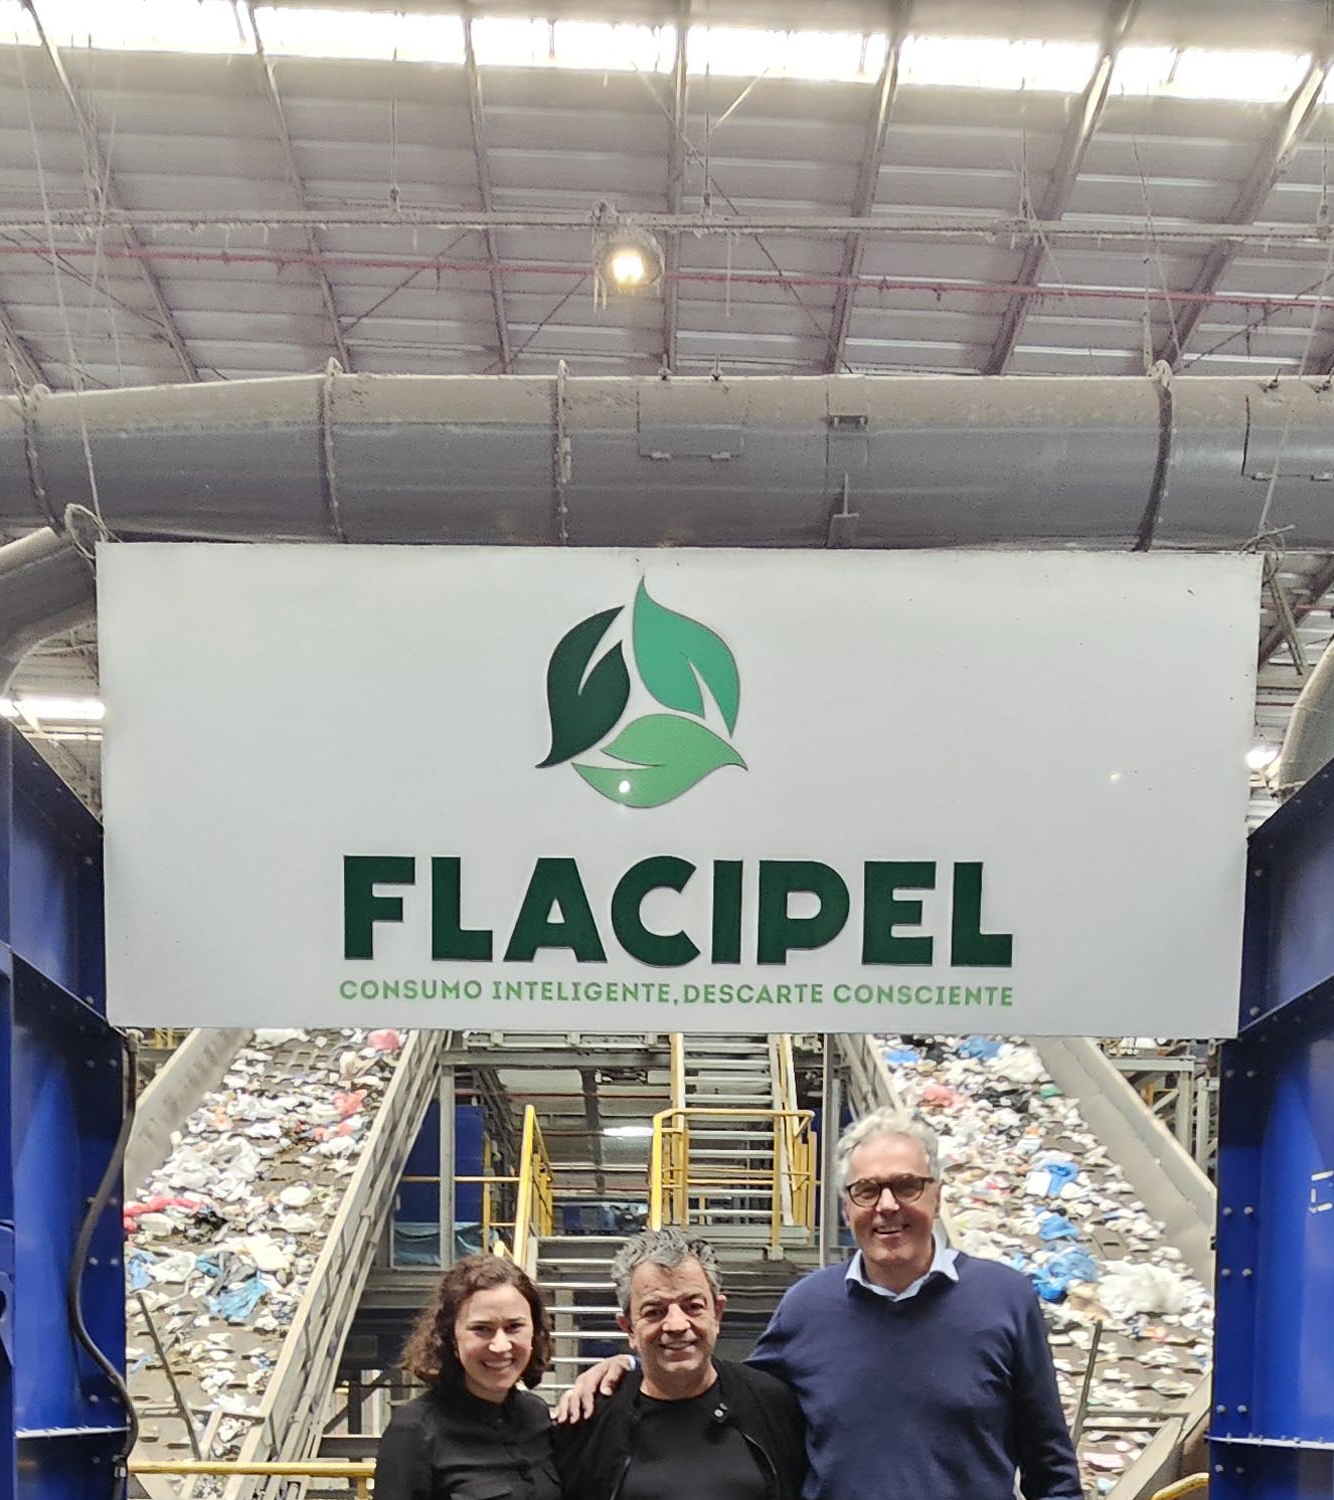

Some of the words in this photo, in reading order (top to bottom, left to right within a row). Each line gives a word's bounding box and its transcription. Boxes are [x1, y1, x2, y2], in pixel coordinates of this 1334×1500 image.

[343, 854, 1014, 968] FLACIPEL
[339, 980, 482, 1001] CONSUMO
[833, 984, 1013, 1007] CONSCIENTE
